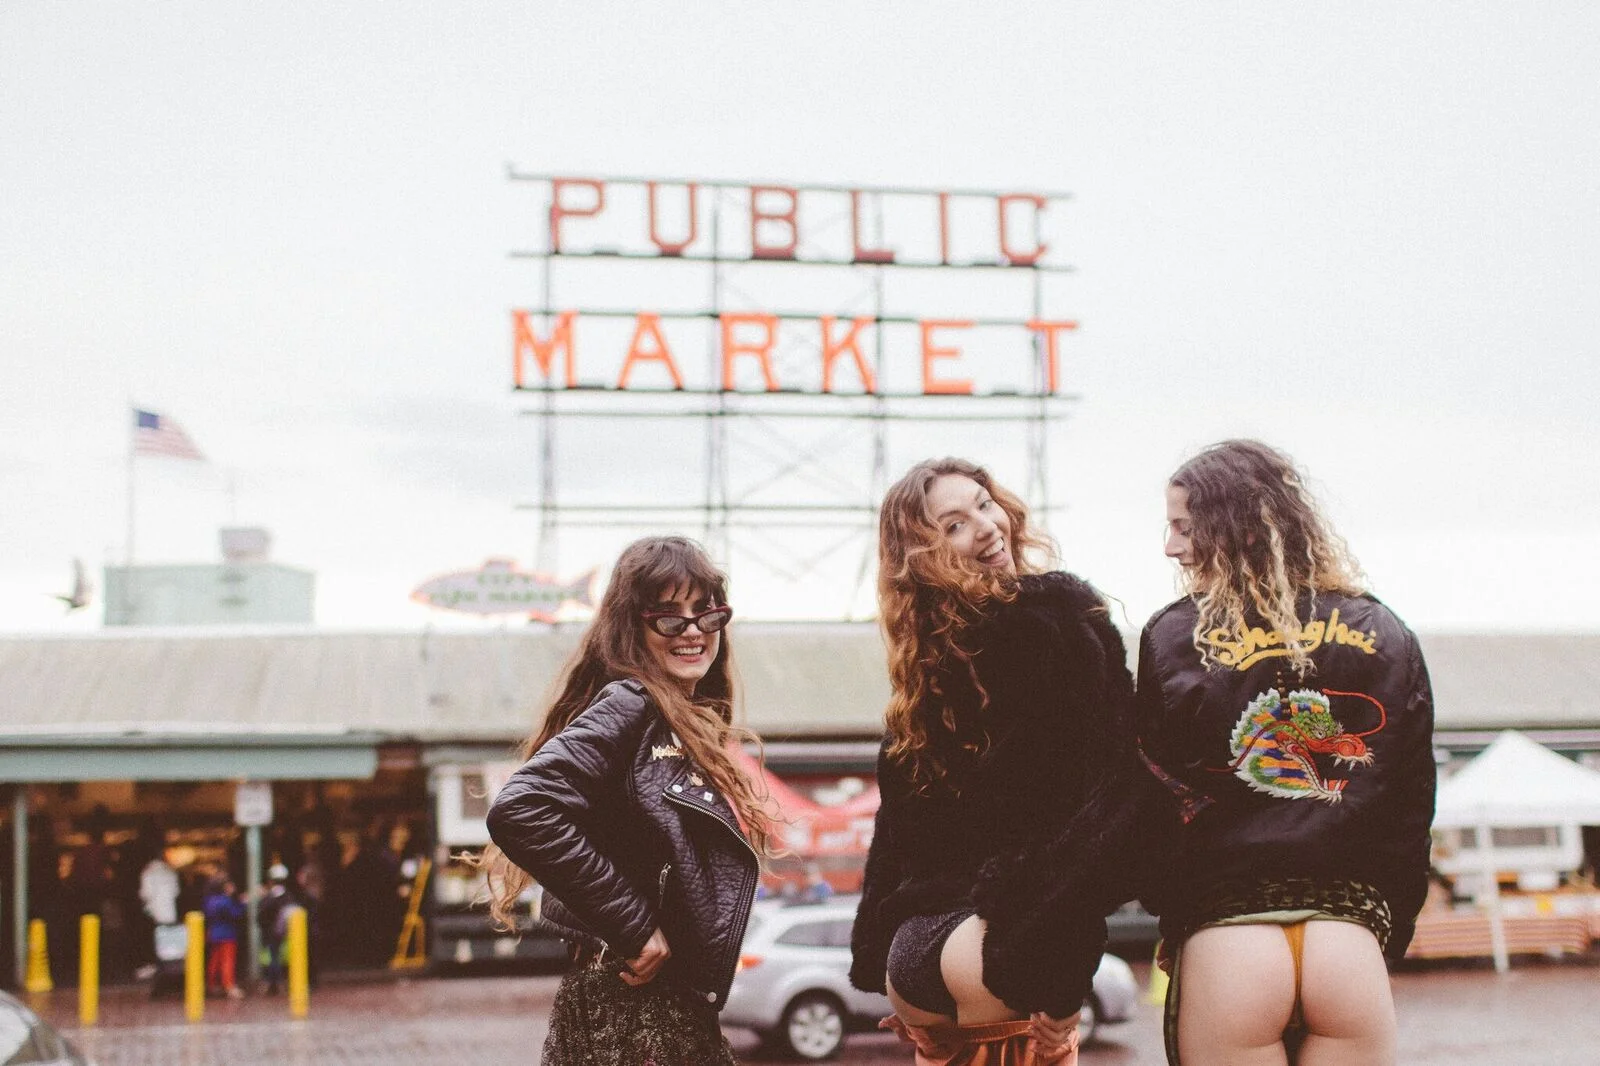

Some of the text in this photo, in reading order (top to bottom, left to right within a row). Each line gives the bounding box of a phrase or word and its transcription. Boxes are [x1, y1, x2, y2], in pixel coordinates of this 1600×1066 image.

[552, 178, 1047, 266] PUBLIC
[511, 310, 1078, 395] MARKET
[1207, 608, 1377, 671] Shaghai
